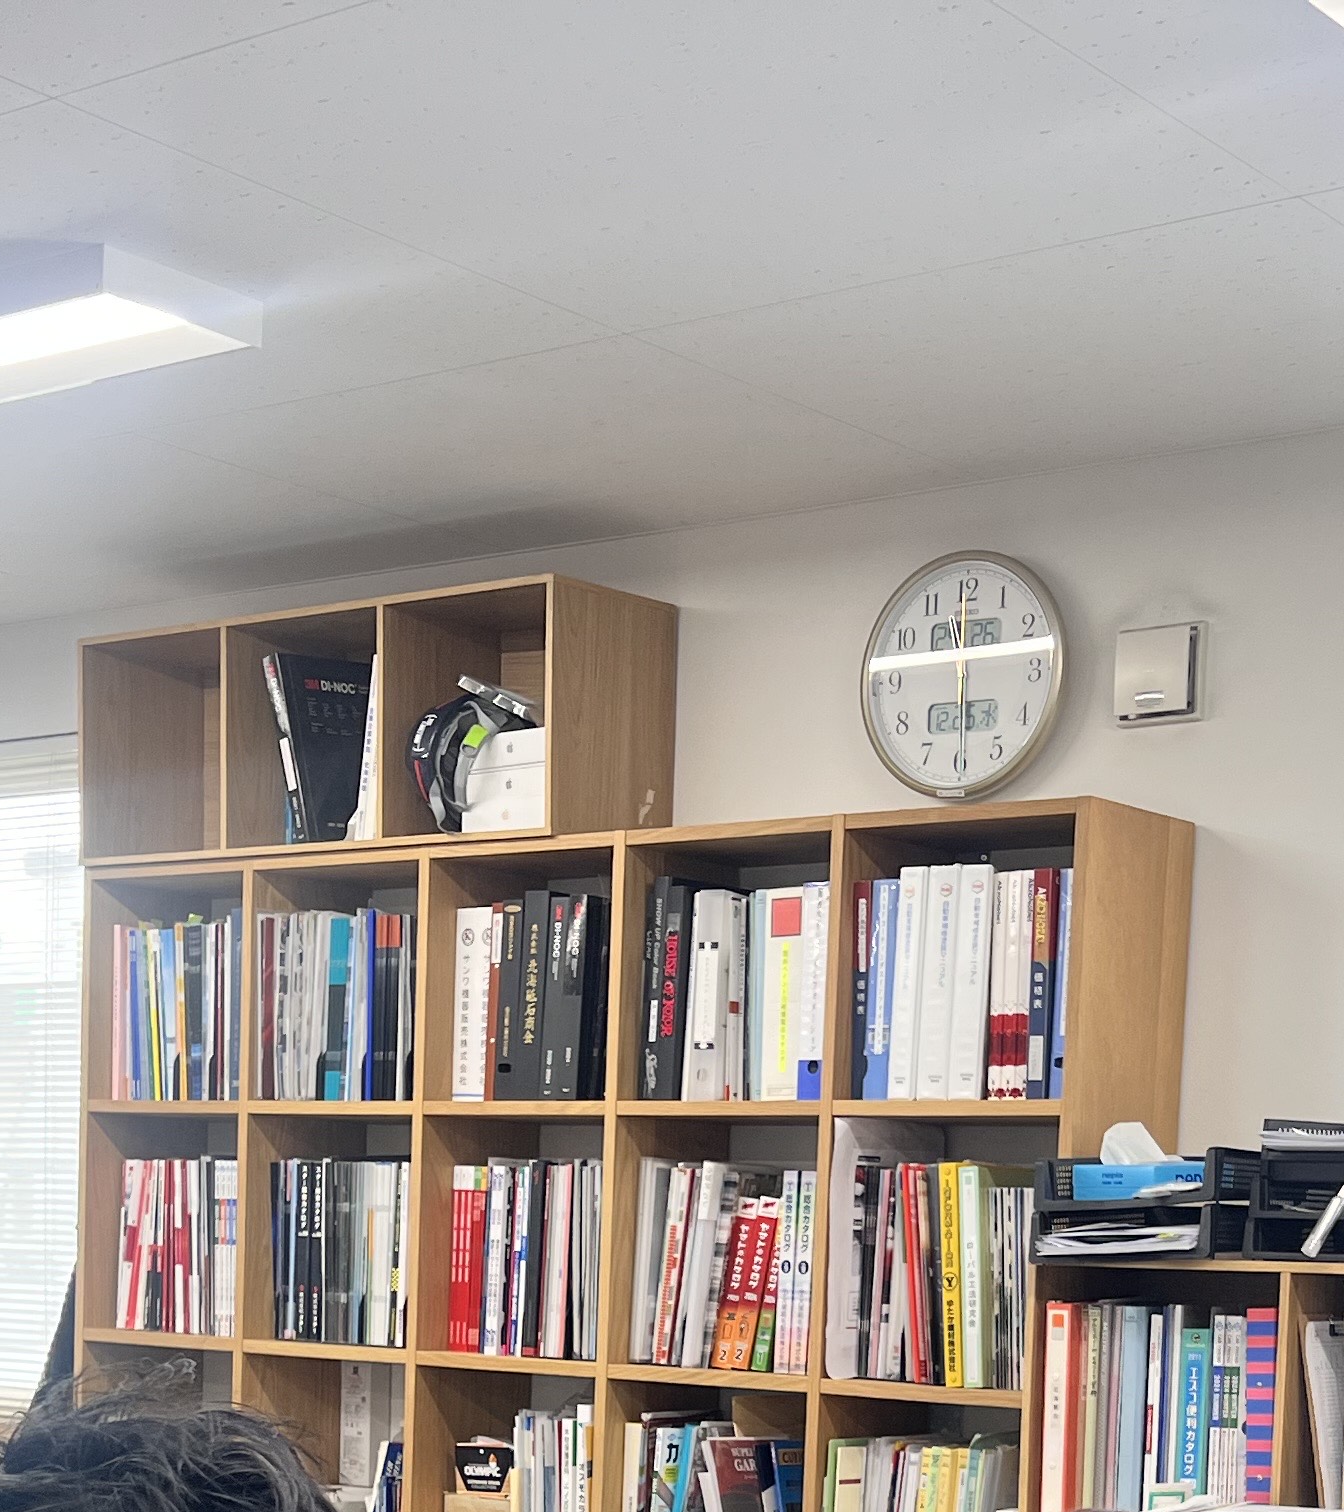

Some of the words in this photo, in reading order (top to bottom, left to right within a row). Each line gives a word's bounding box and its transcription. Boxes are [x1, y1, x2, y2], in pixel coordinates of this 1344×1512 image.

[957, 578, 979, 604] 12
[998, 586, 1007, 609] 1
[924, 593, 939, 617] 11
[1022, 613, 1035, 638] 2
[897, 627, 916, 651] 10
[1028, 657, 1042, 682] 3
[320, 680, 356, 694] DI-NOC
[888, 671, 902, 695] 9
[896, 711, 909, 735] 8
[1016, 702, 1031, 726] 4
[920, 742, 933, 766] 7
[989, 735, 1003, 761] 5
[953, 750, 967, 774] 6
[799, 1193, 812, 1254] 総合カタログ
[719, 1348, 728, 1361] 2
[734, 1348, 744, 1361] 2
[1184, 1366, 1199, 1477] エスコ便利カタログ
